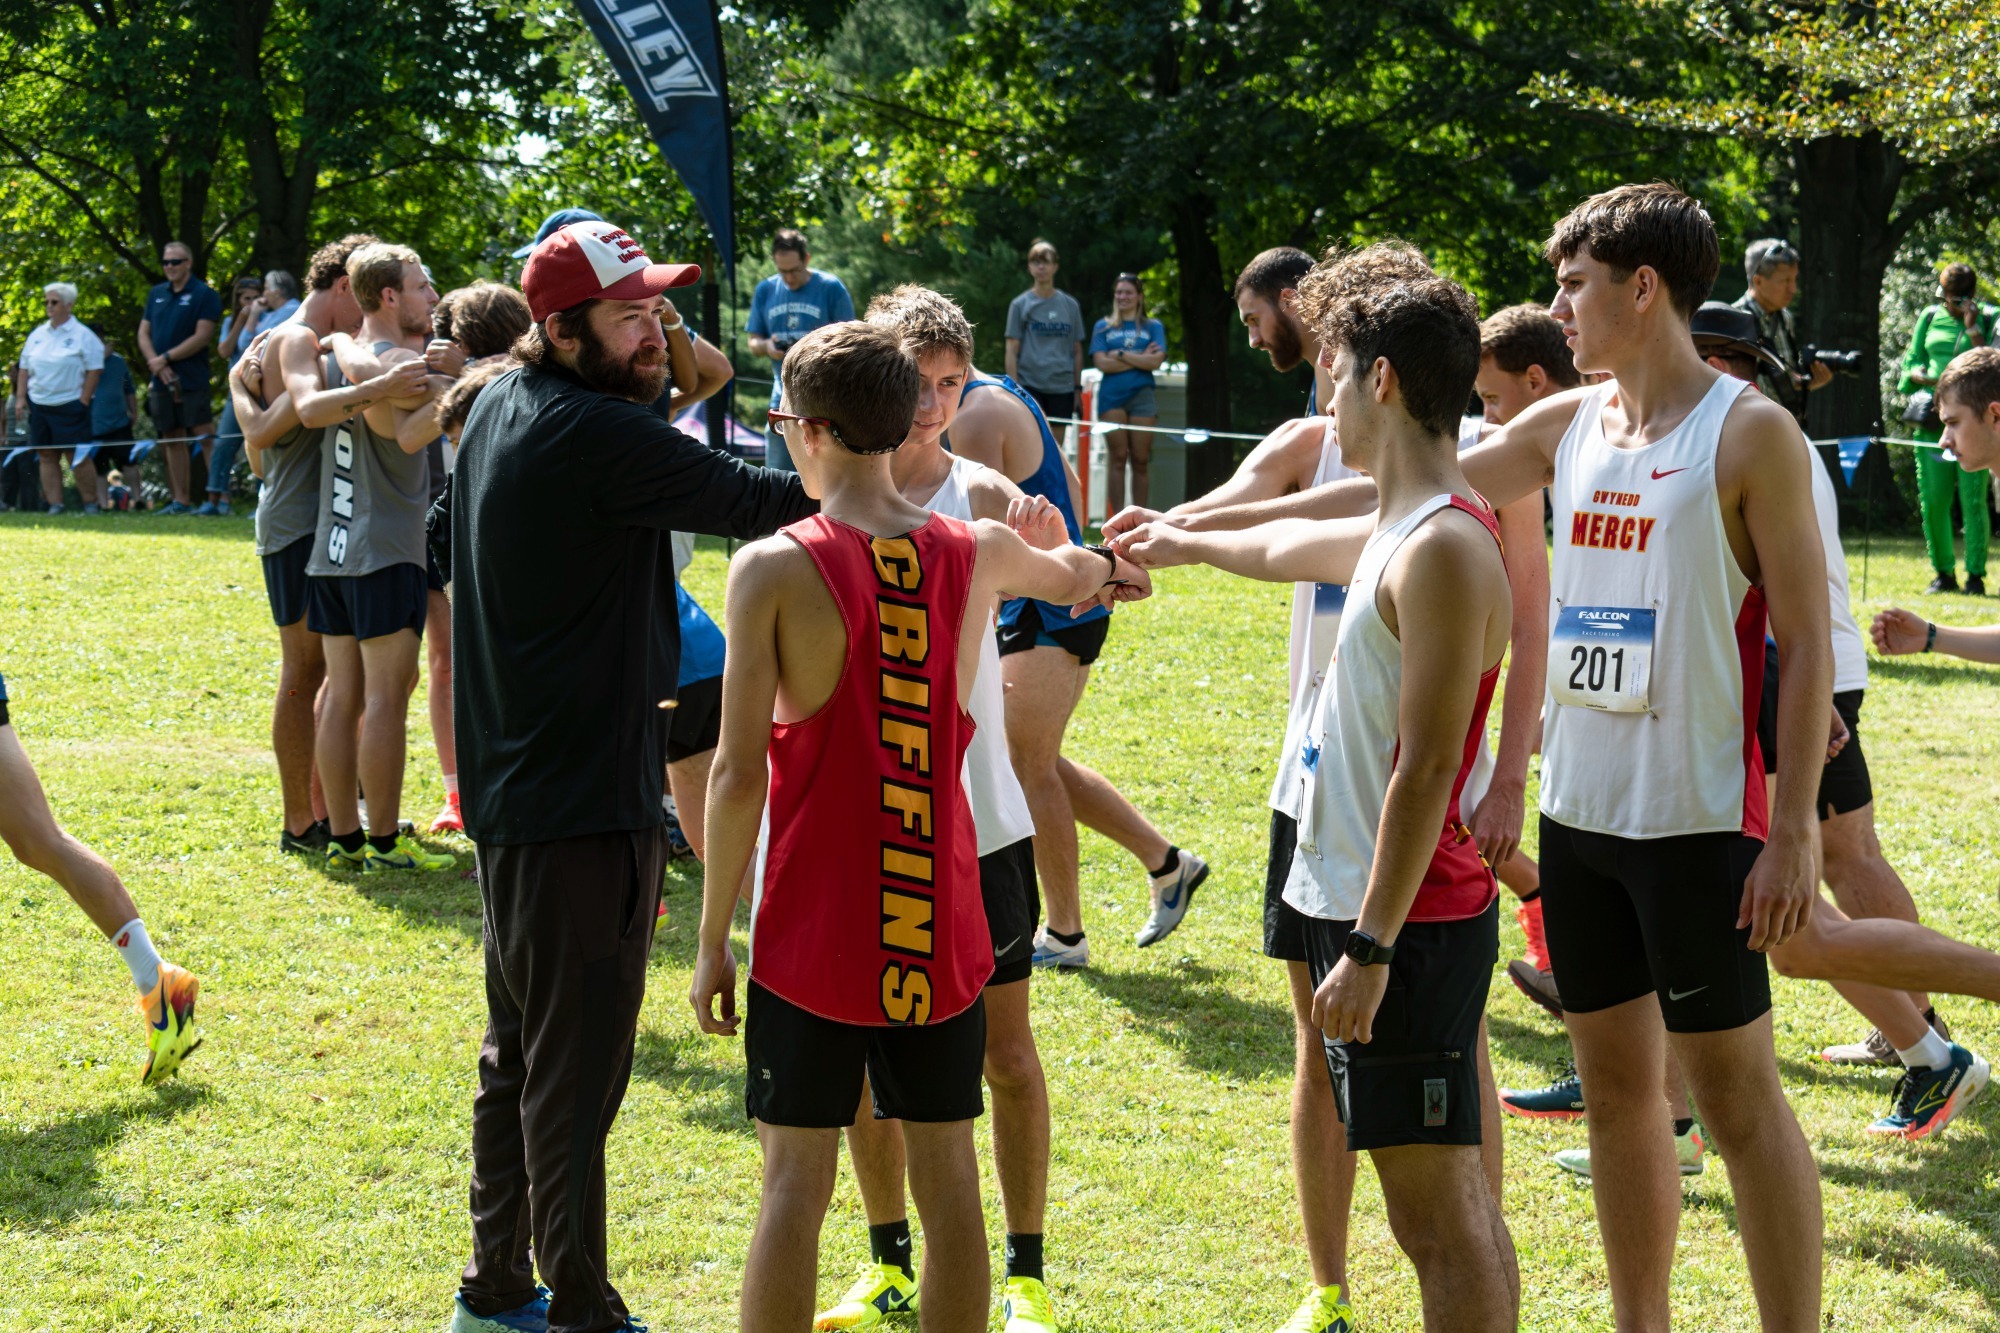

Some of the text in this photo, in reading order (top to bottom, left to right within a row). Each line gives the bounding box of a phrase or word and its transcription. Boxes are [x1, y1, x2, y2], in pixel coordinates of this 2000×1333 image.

[600, 0, 703, 92] LEY
[327, 424, 354, 567] ONS
[1592, 490, 1641, 507] GWYNEDD
[1570, 510, 1657, 553] MERCY
[1578, 611, 1630, 621] FALCON
[1569, 645, 1624, 692] 201
[870, 534, 935, 1026] GRIFFINS
[1941, 1067, 1960, 1097] BROOKS
